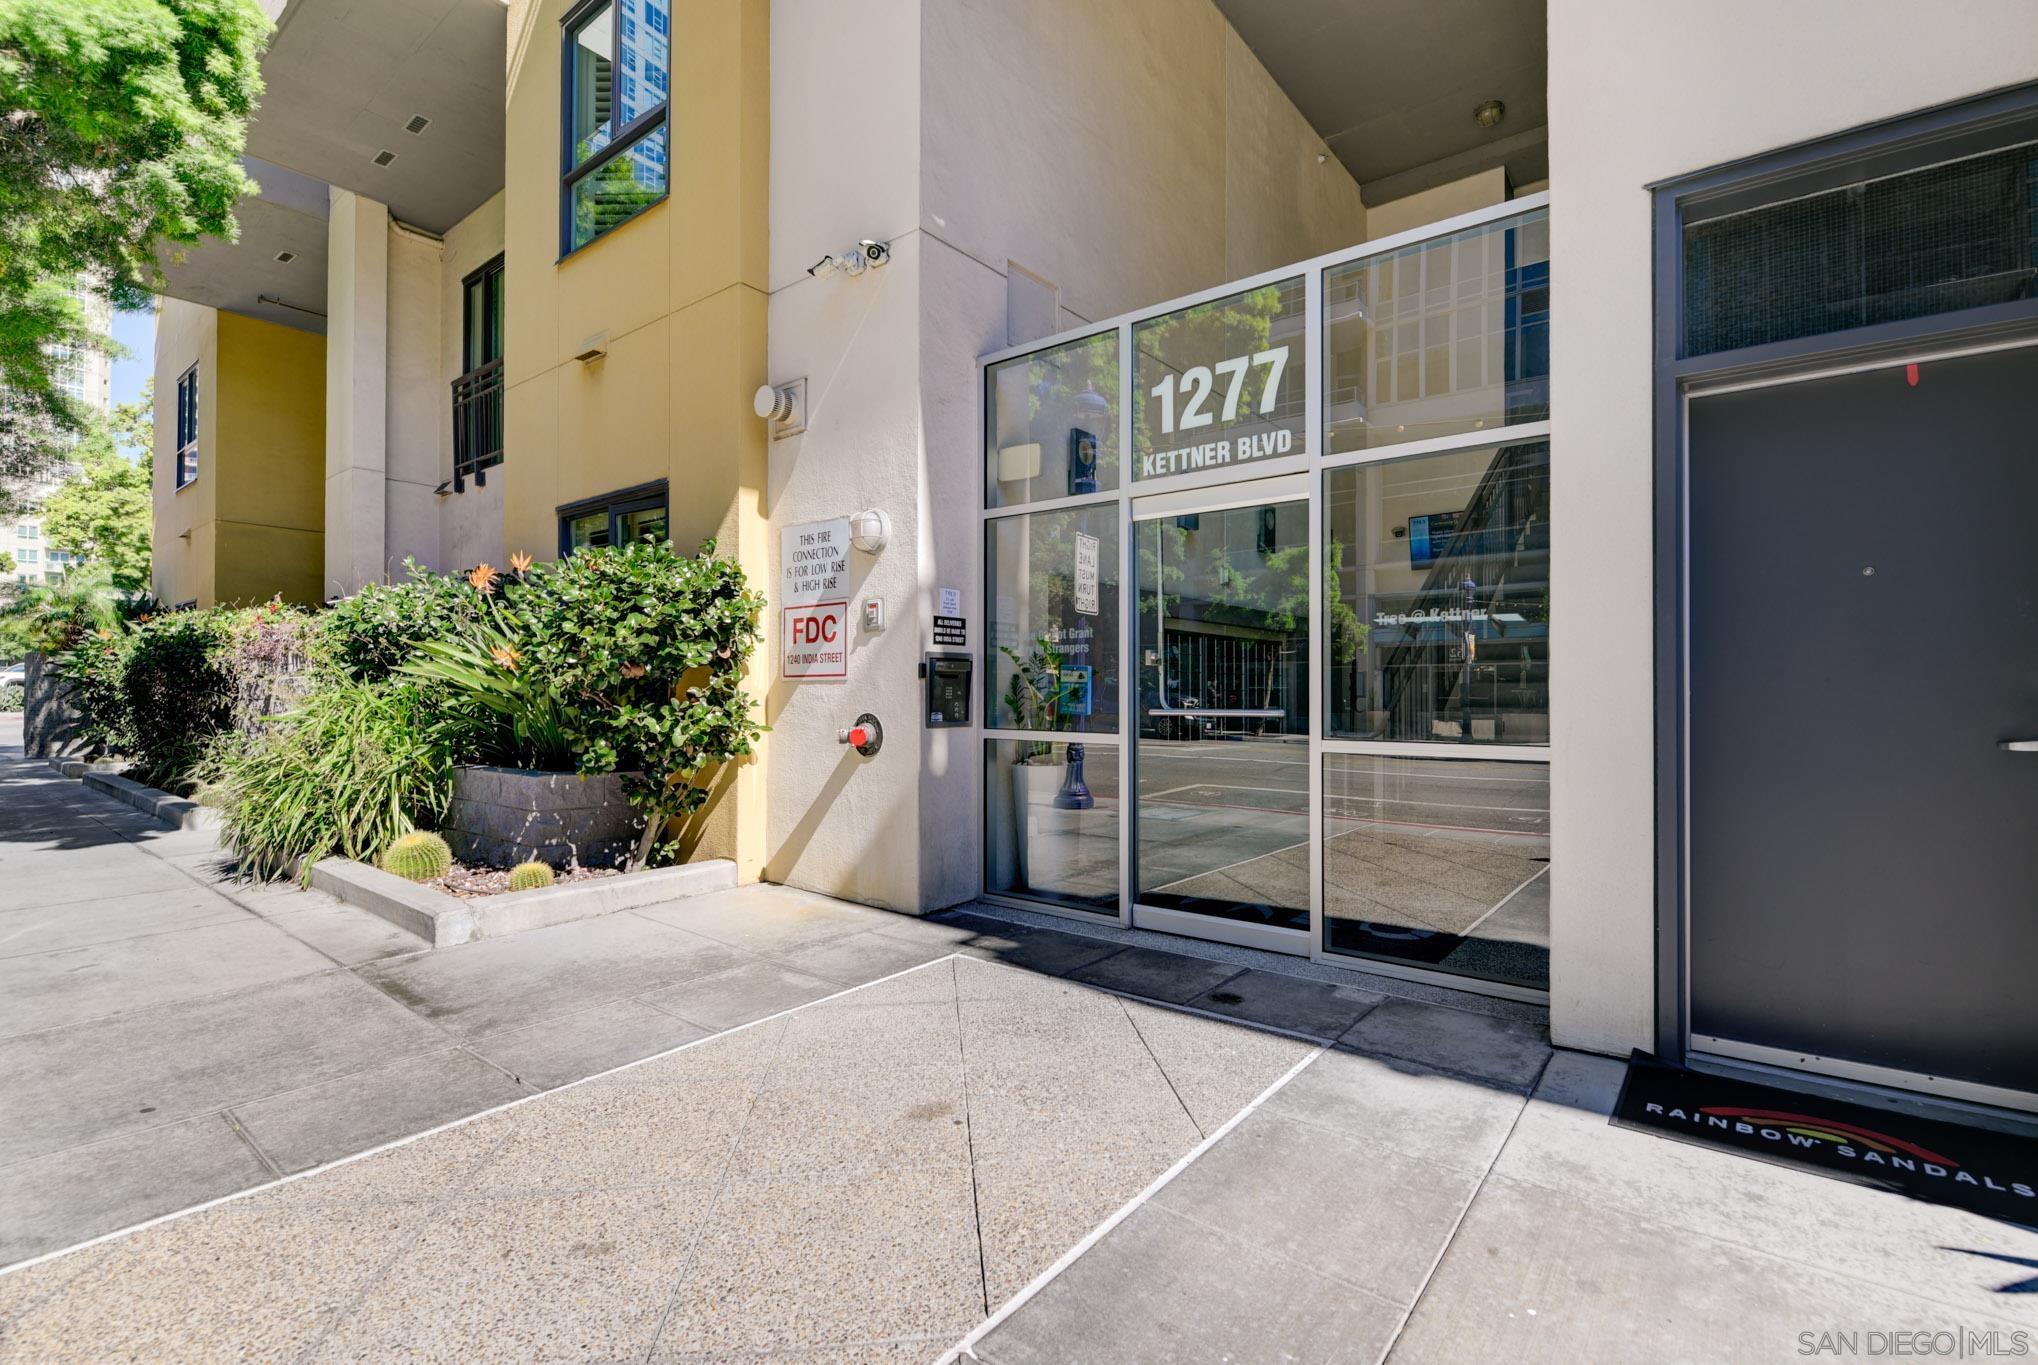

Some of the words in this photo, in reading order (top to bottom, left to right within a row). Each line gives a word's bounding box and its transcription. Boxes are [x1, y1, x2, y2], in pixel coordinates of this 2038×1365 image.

[1151, 345, 1289, 434] 1277
[1142, 440, 1231, 477] KETTNER
[1237, 429, 1292, 460] BLVD
[800, 533, 814, 546] THIS
[817, 531, 831, 543] FIRE
[792, 545, 839, 562] CONNECTION
[786, 567, 792, 579] IS
[794, 565, 808, 577] FOR
[811, 561, 827, 576] LOW
[831, 560, 845, 573] RISE
[793, 581, 799, 593] &
[802, 578, 820, 591] HIGH
[822, 576, 837, 590] RISE
[1430, 607, 1487, 623] Kettner
[793, 614, 837, 645] FDC
[1068, 627, 1094, 640] Grant
[1047, 643, 1090, 656] Strangers
[787, 654, 801, 665] 1240
[801, 653, 818, 664] INDIA
[819, 652, 843, 664] STREET
[1645, 1102, 1815, 1149] RAINBOW
[1837, 1144, 2037, 1198] SANDALS
